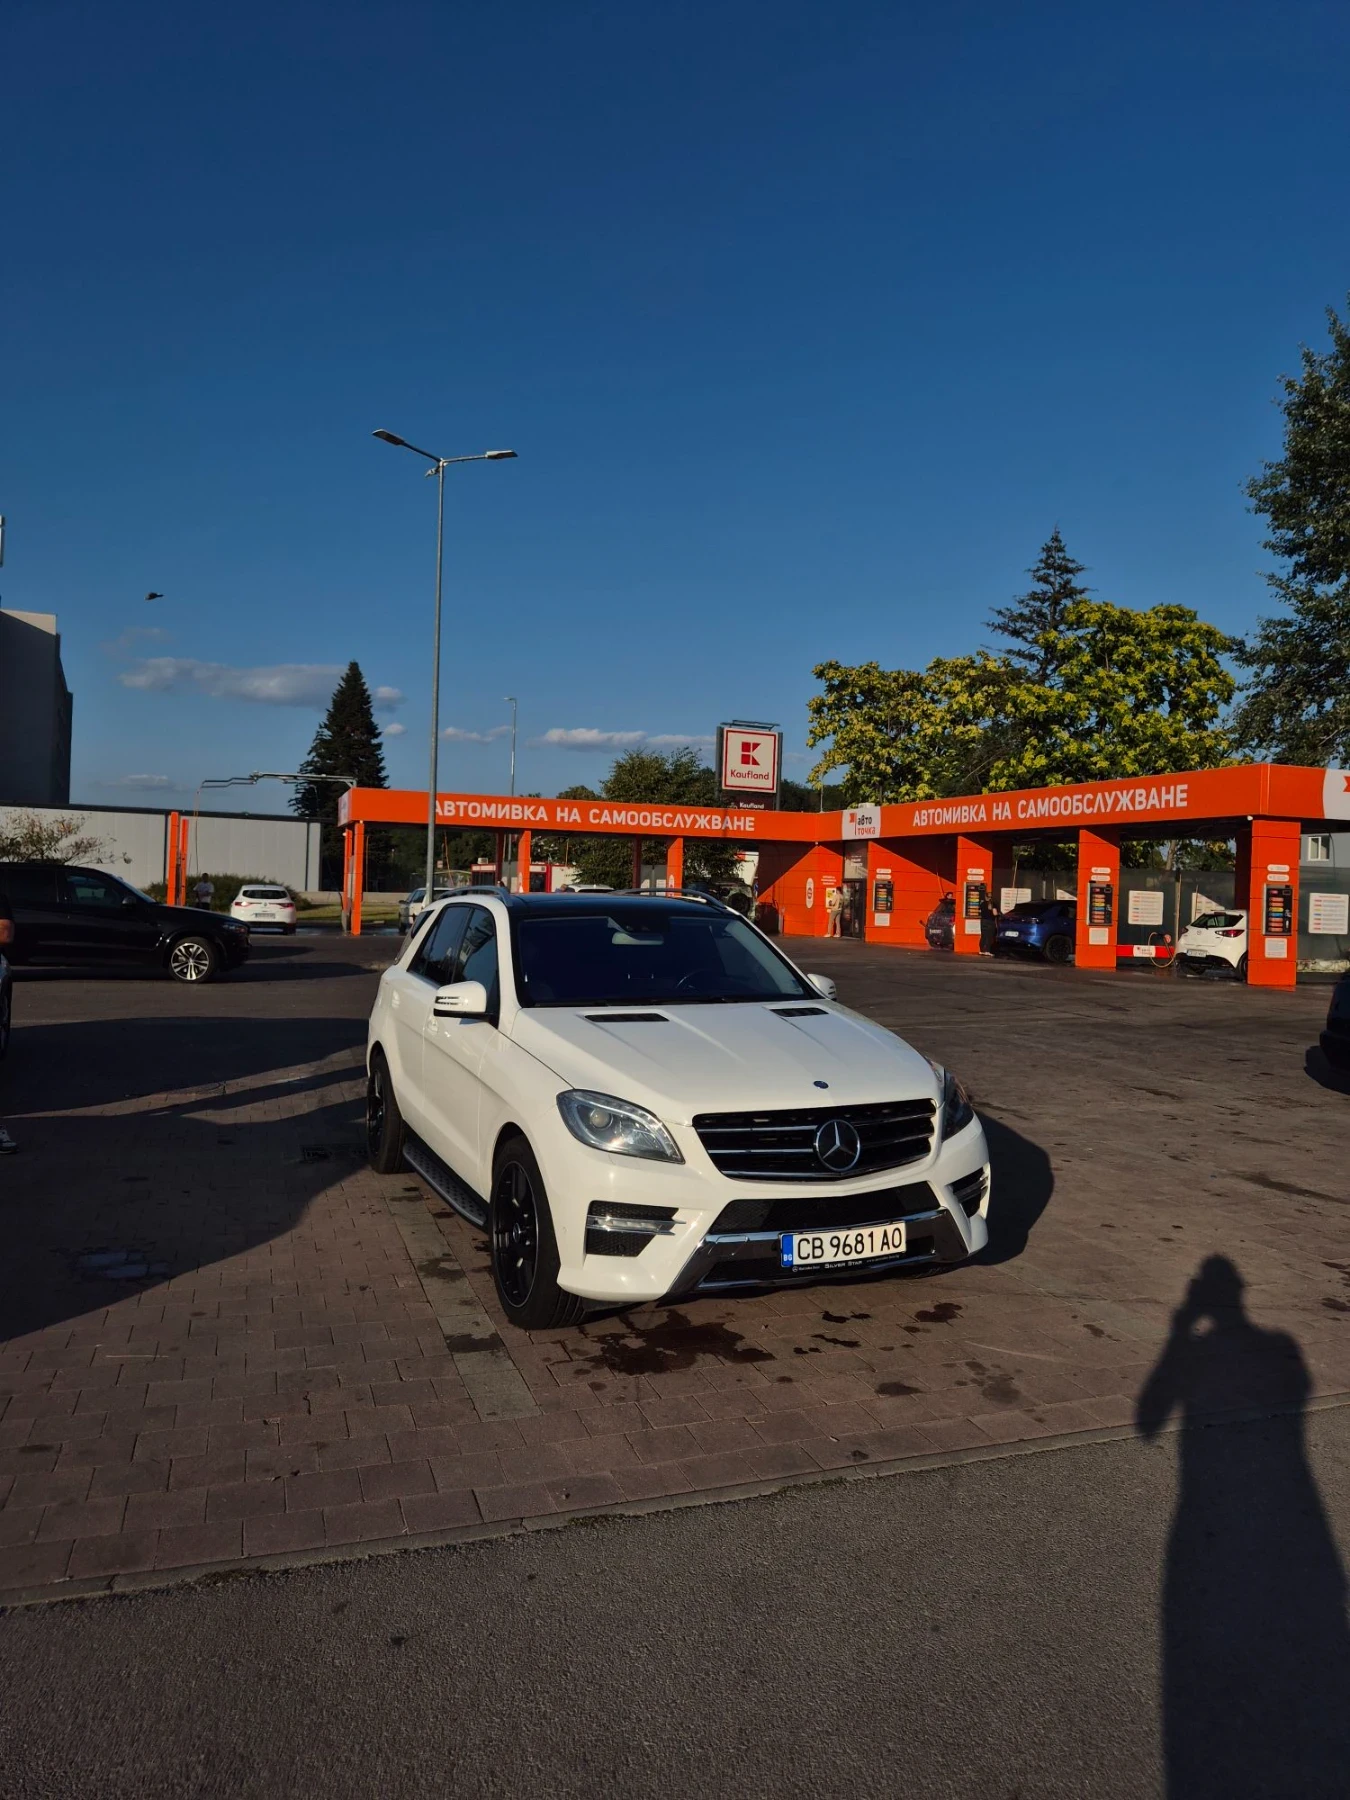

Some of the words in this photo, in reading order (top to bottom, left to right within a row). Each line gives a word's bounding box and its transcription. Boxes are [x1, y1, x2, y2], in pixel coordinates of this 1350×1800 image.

[730, 769, 770, 781] Kaufland
[435, 800, 548, 821] АВТОМИВКА
[556, 807, 581, 823] НА
[589, 808, 755, 831] САМООБСЛУЖВАНЕ
[912, 803, 987, 827] АВТОМИВКА
[992, 801, 1011, 821] НА
[1017, 784, 1188, 819] САМООБСЛУЖВАНЕ
[783, 1254, 793, 1262] BG
[797, 1237, 824, 1260] CB
[829, 1230, 875, 1258] 9681
